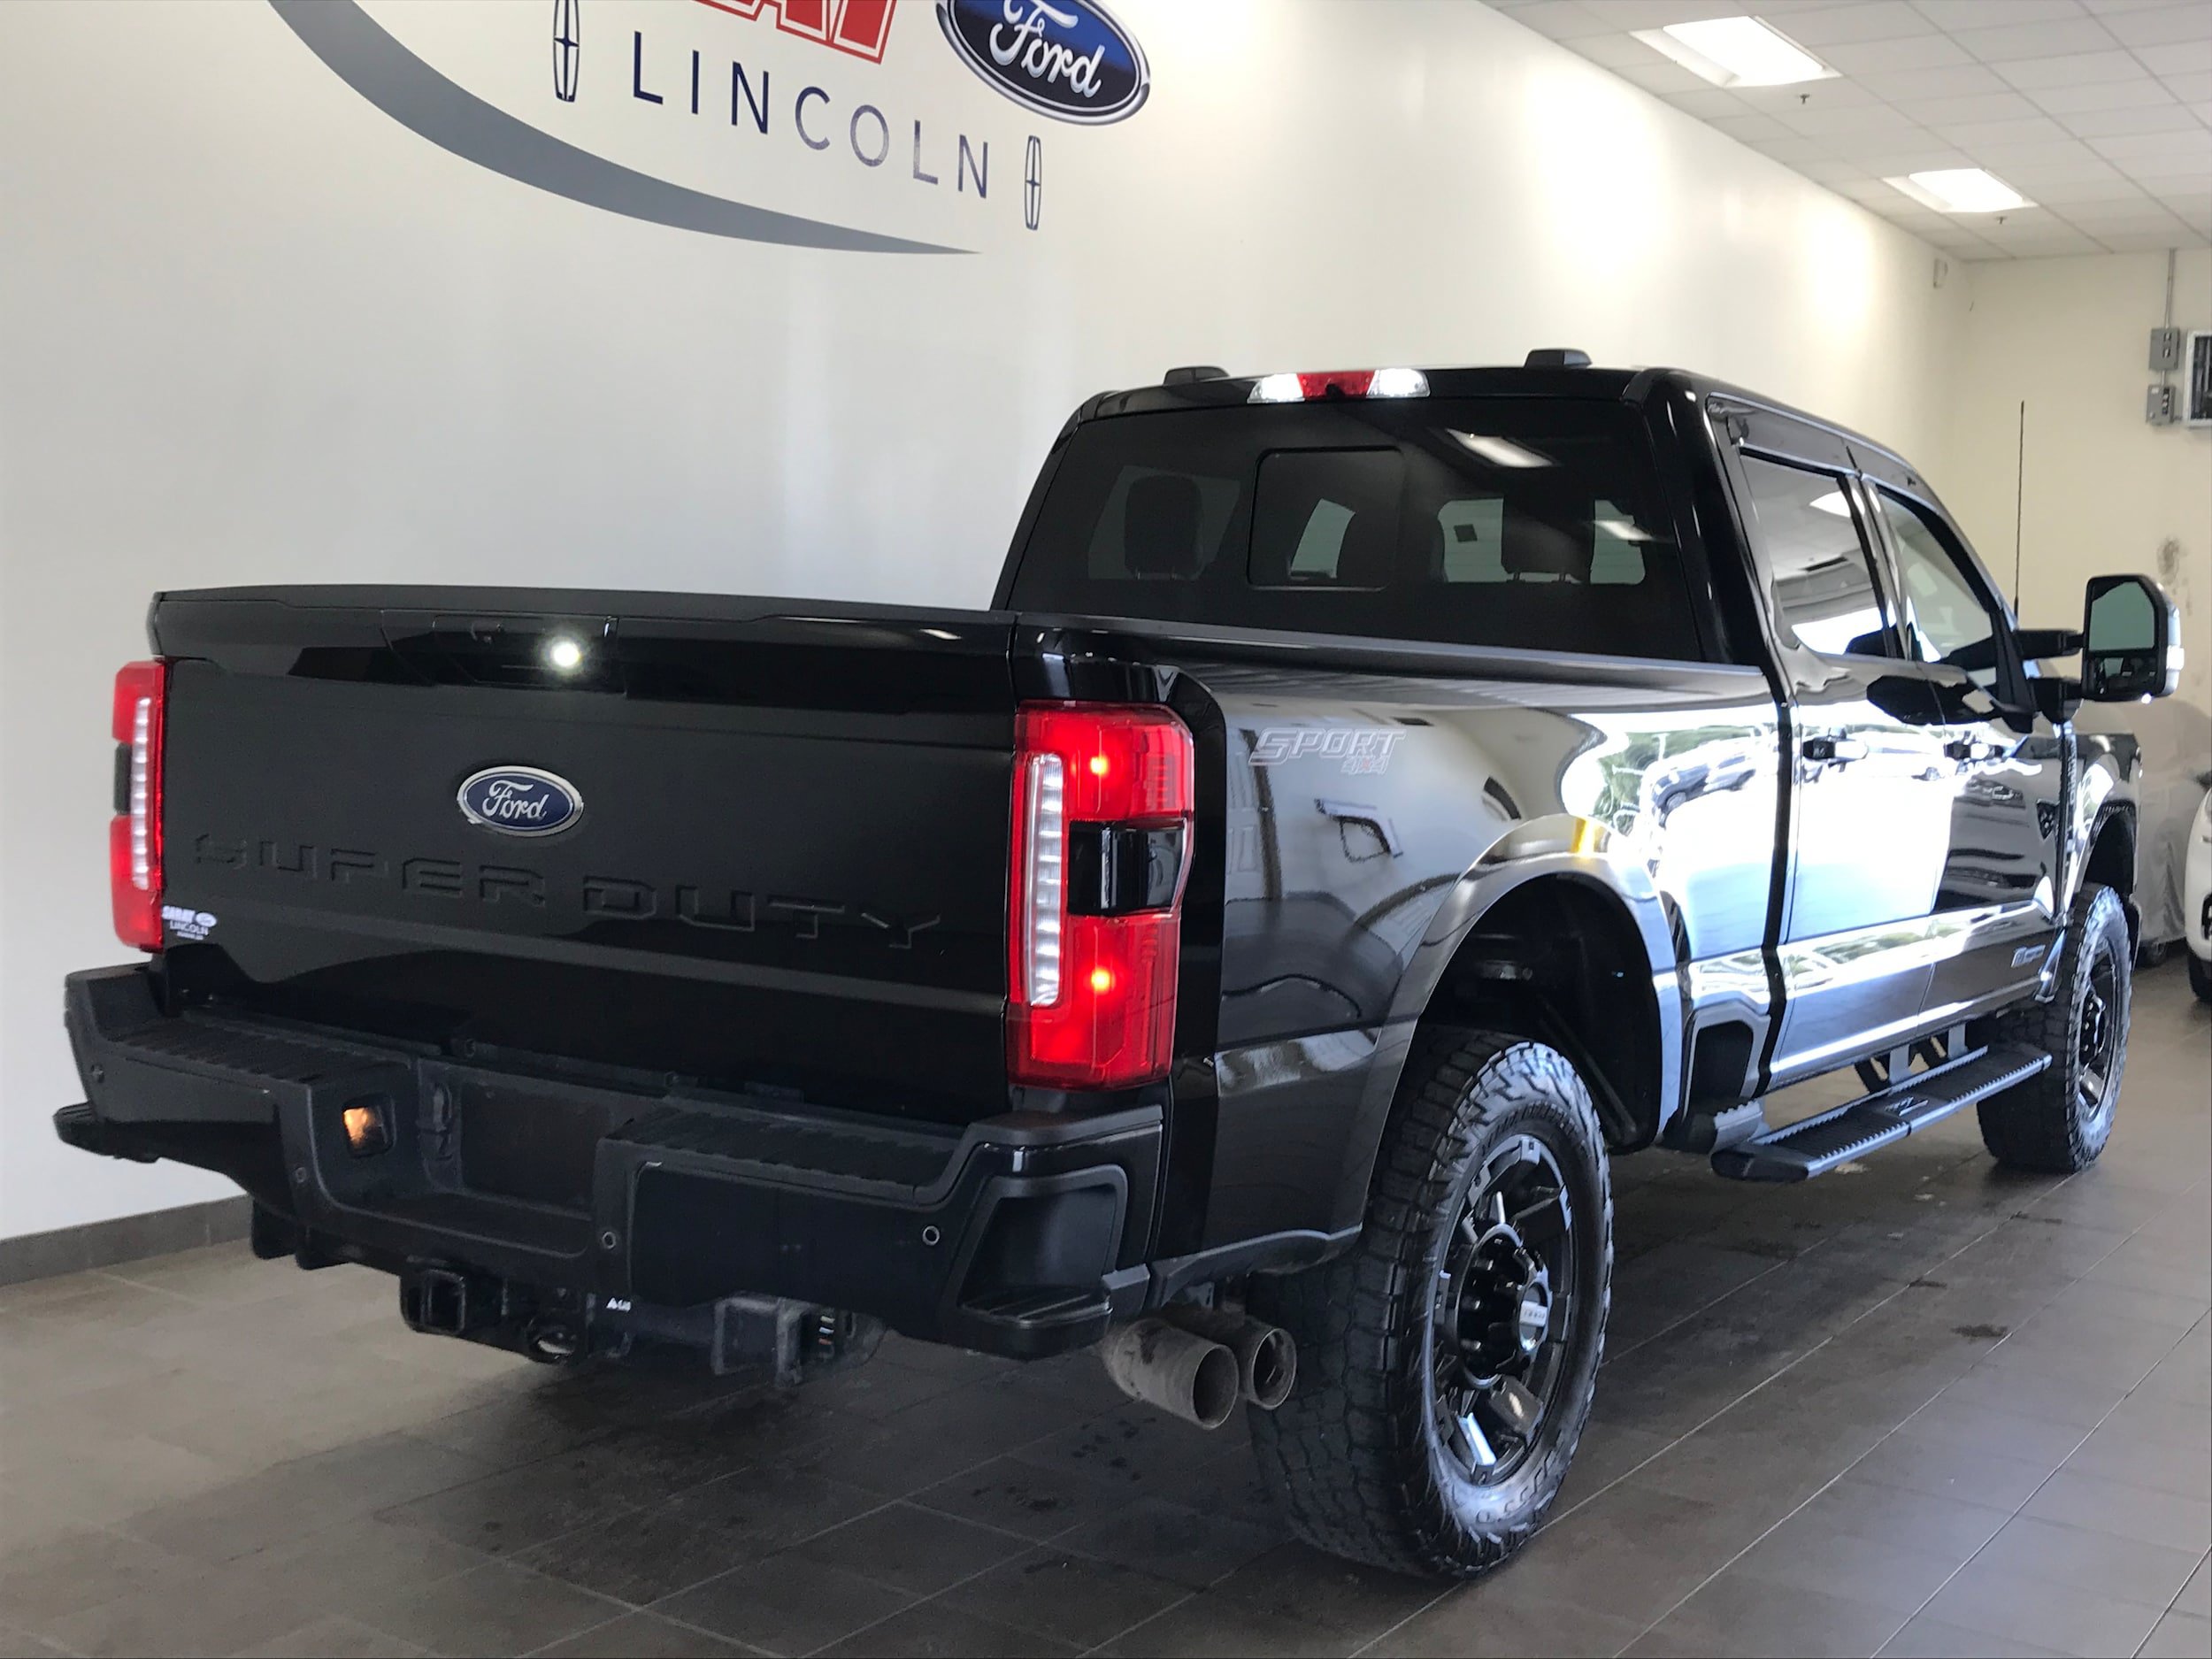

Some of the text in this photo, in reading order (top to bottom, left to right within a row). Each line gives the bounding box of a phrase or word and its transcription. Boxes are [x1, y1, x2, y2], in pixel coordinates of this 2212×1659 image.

[988, 0, 1106, 98] Ford
[632, 31, 989, 199] LINCOLN
[1248, 727, 1407, 766] SPORT
[481, 780, 550, 821] Ford
[194, 833, 941, 949] SUPER DUTY
